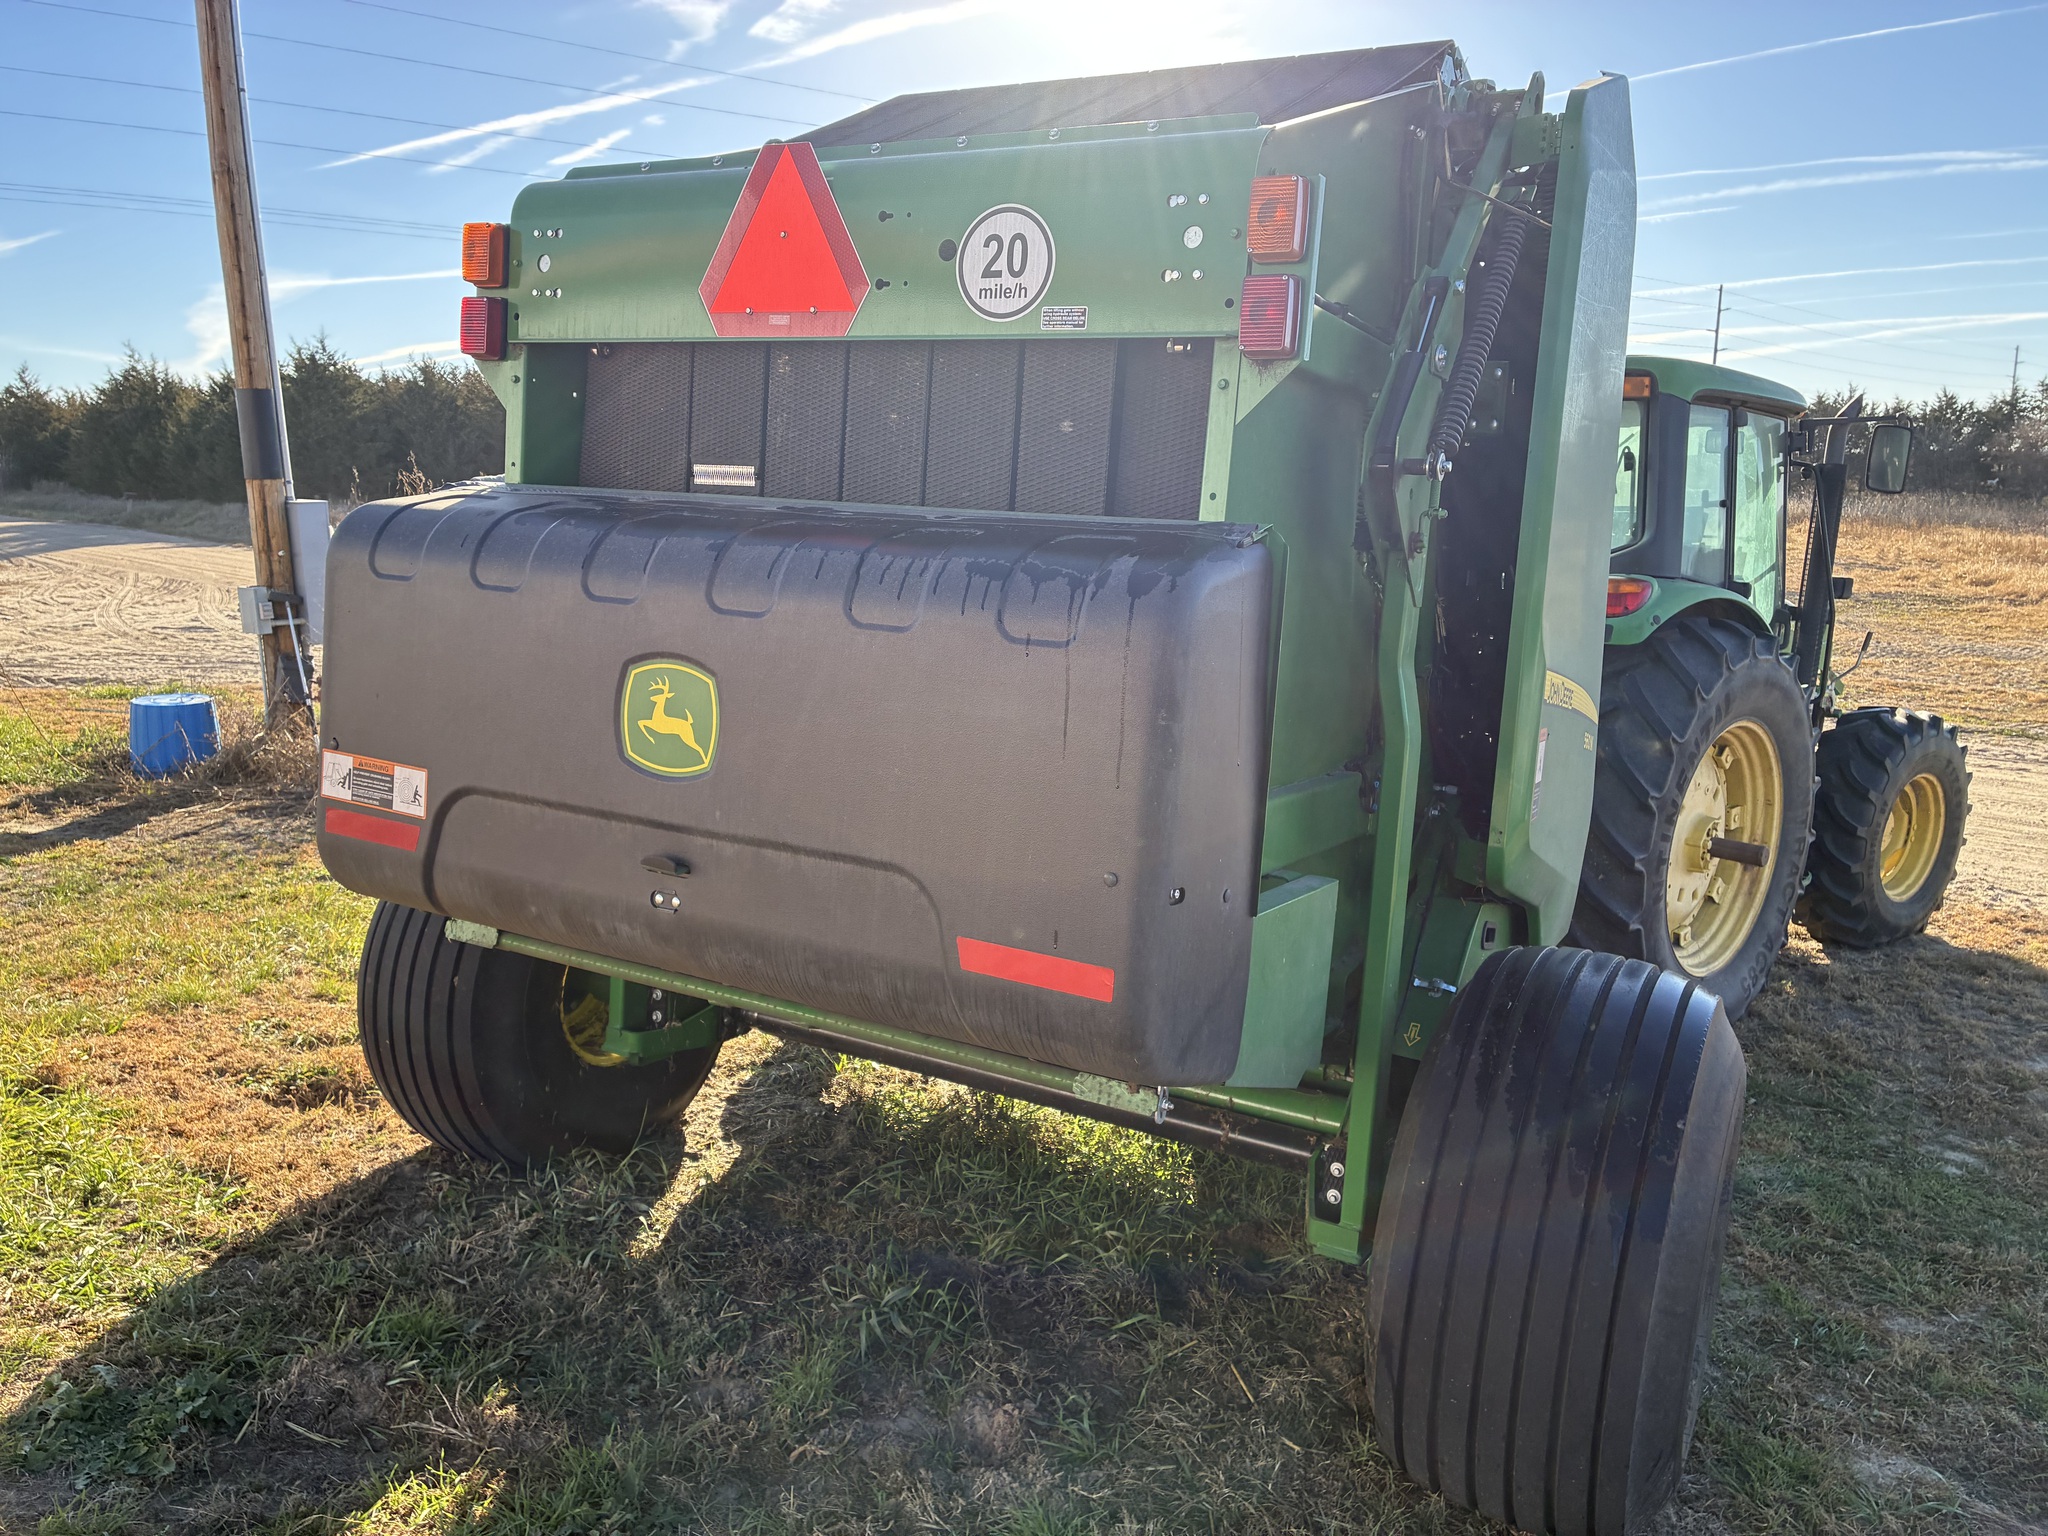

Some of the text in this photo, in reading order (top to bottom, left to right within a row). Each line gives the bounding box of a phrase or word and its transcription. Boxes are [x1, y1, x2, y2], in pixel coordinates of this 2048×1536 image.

[981, 232, 1029, 279] 20
[979, 282, 1028, 300] mile/h
[363, 761, 389, 772] WARNING
[1739, 934, 1775, 1002] AC85
